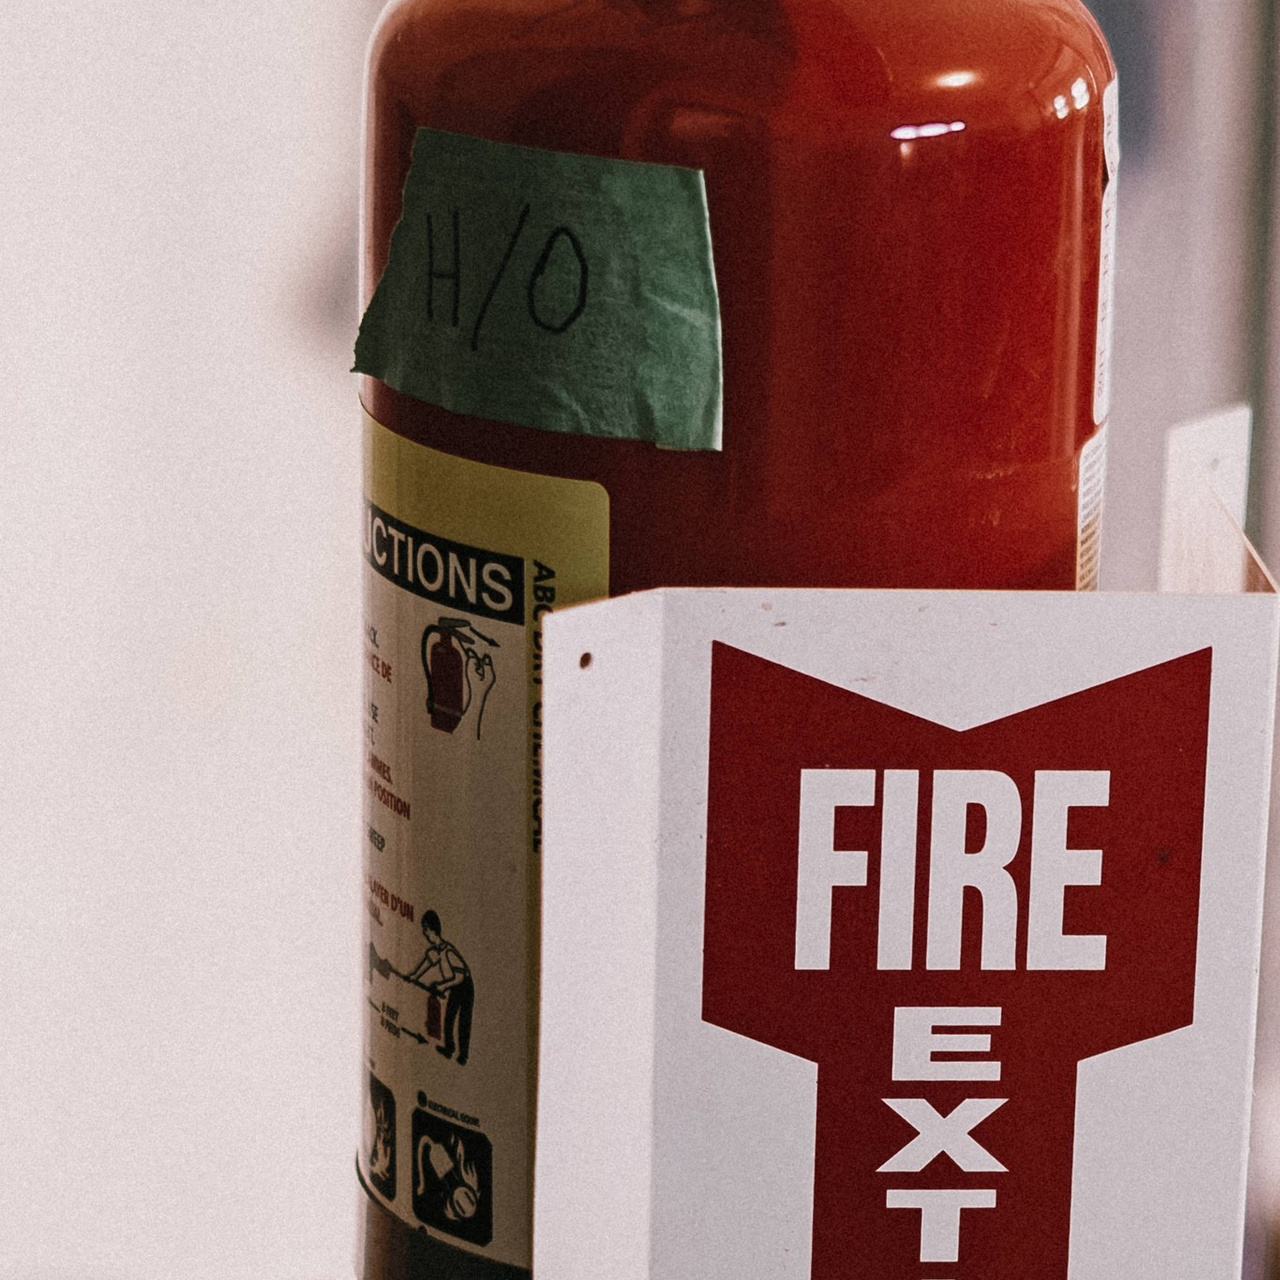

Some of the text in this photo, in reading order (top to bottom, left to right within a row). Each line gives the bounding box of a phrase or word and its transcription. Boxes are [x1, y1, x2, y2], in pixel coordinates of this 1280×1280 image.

[426, 202, 589, 352] H/O
[373, 780, 411, 821] POSITION
[390, 893, 414, 923] D'UN
[795, 768, 1111, 970] FIRE
